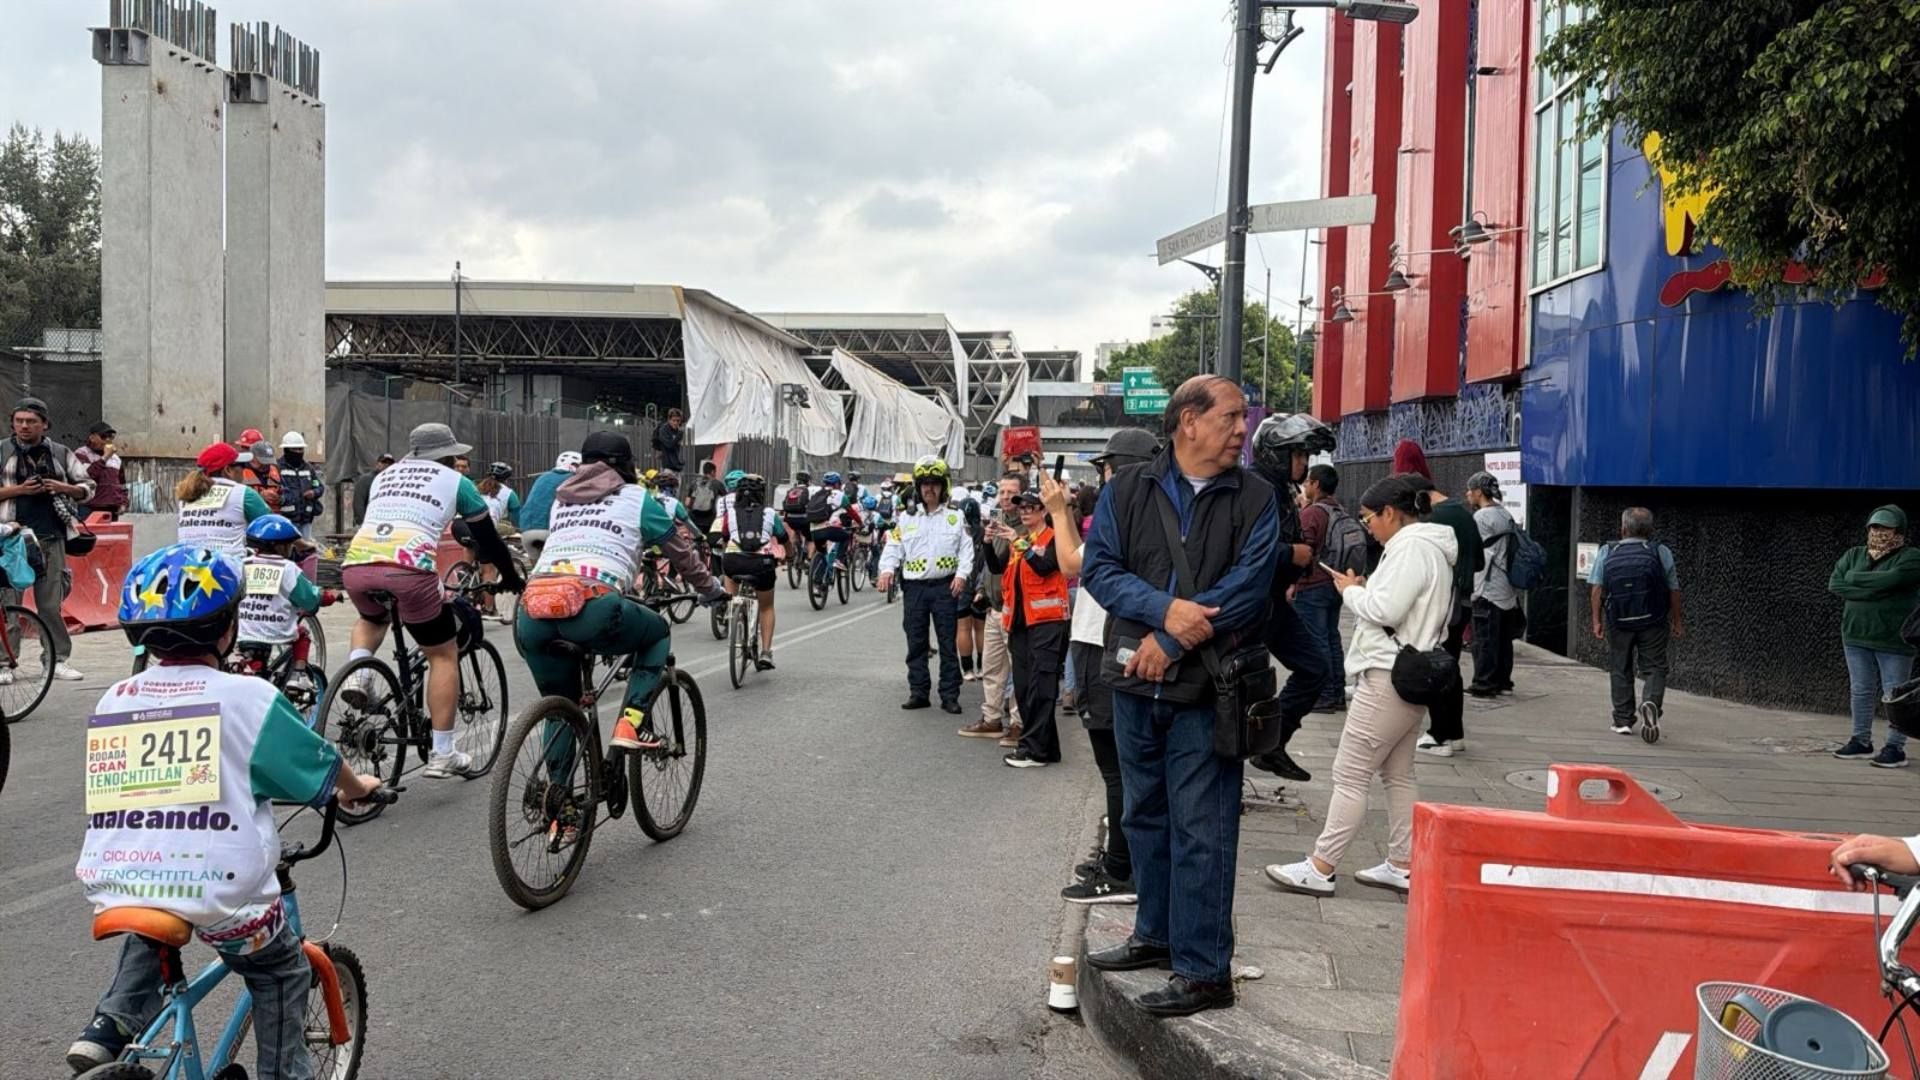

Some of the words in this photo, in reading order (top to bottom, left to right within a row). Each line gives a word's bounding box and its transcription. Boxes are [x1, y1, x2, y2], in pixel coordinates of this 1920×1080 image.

[1167, 239, 1180, 255] SAN
[399, 467, 441, 476] CDMX
[400, 474, 433, 483] vive
[379, 482, 426, 490] mejor
[183, 509, 218, 518] mejor
[556, 508, 606, 520] mejor
[253, 567, 280, 581] 0630
[90, 736, 127, 752] BICI
[141, 727, 211, 767] 2412
[89, 750, 127, 762] RODADA
[89, 759, 127, 774] GRAN
[89, 766, 182, 788] TENOCHTITLAN
[102, 850, 162, 863] CICLOVIA
[100, 868, 223, 881] TENOCHTITLAN
